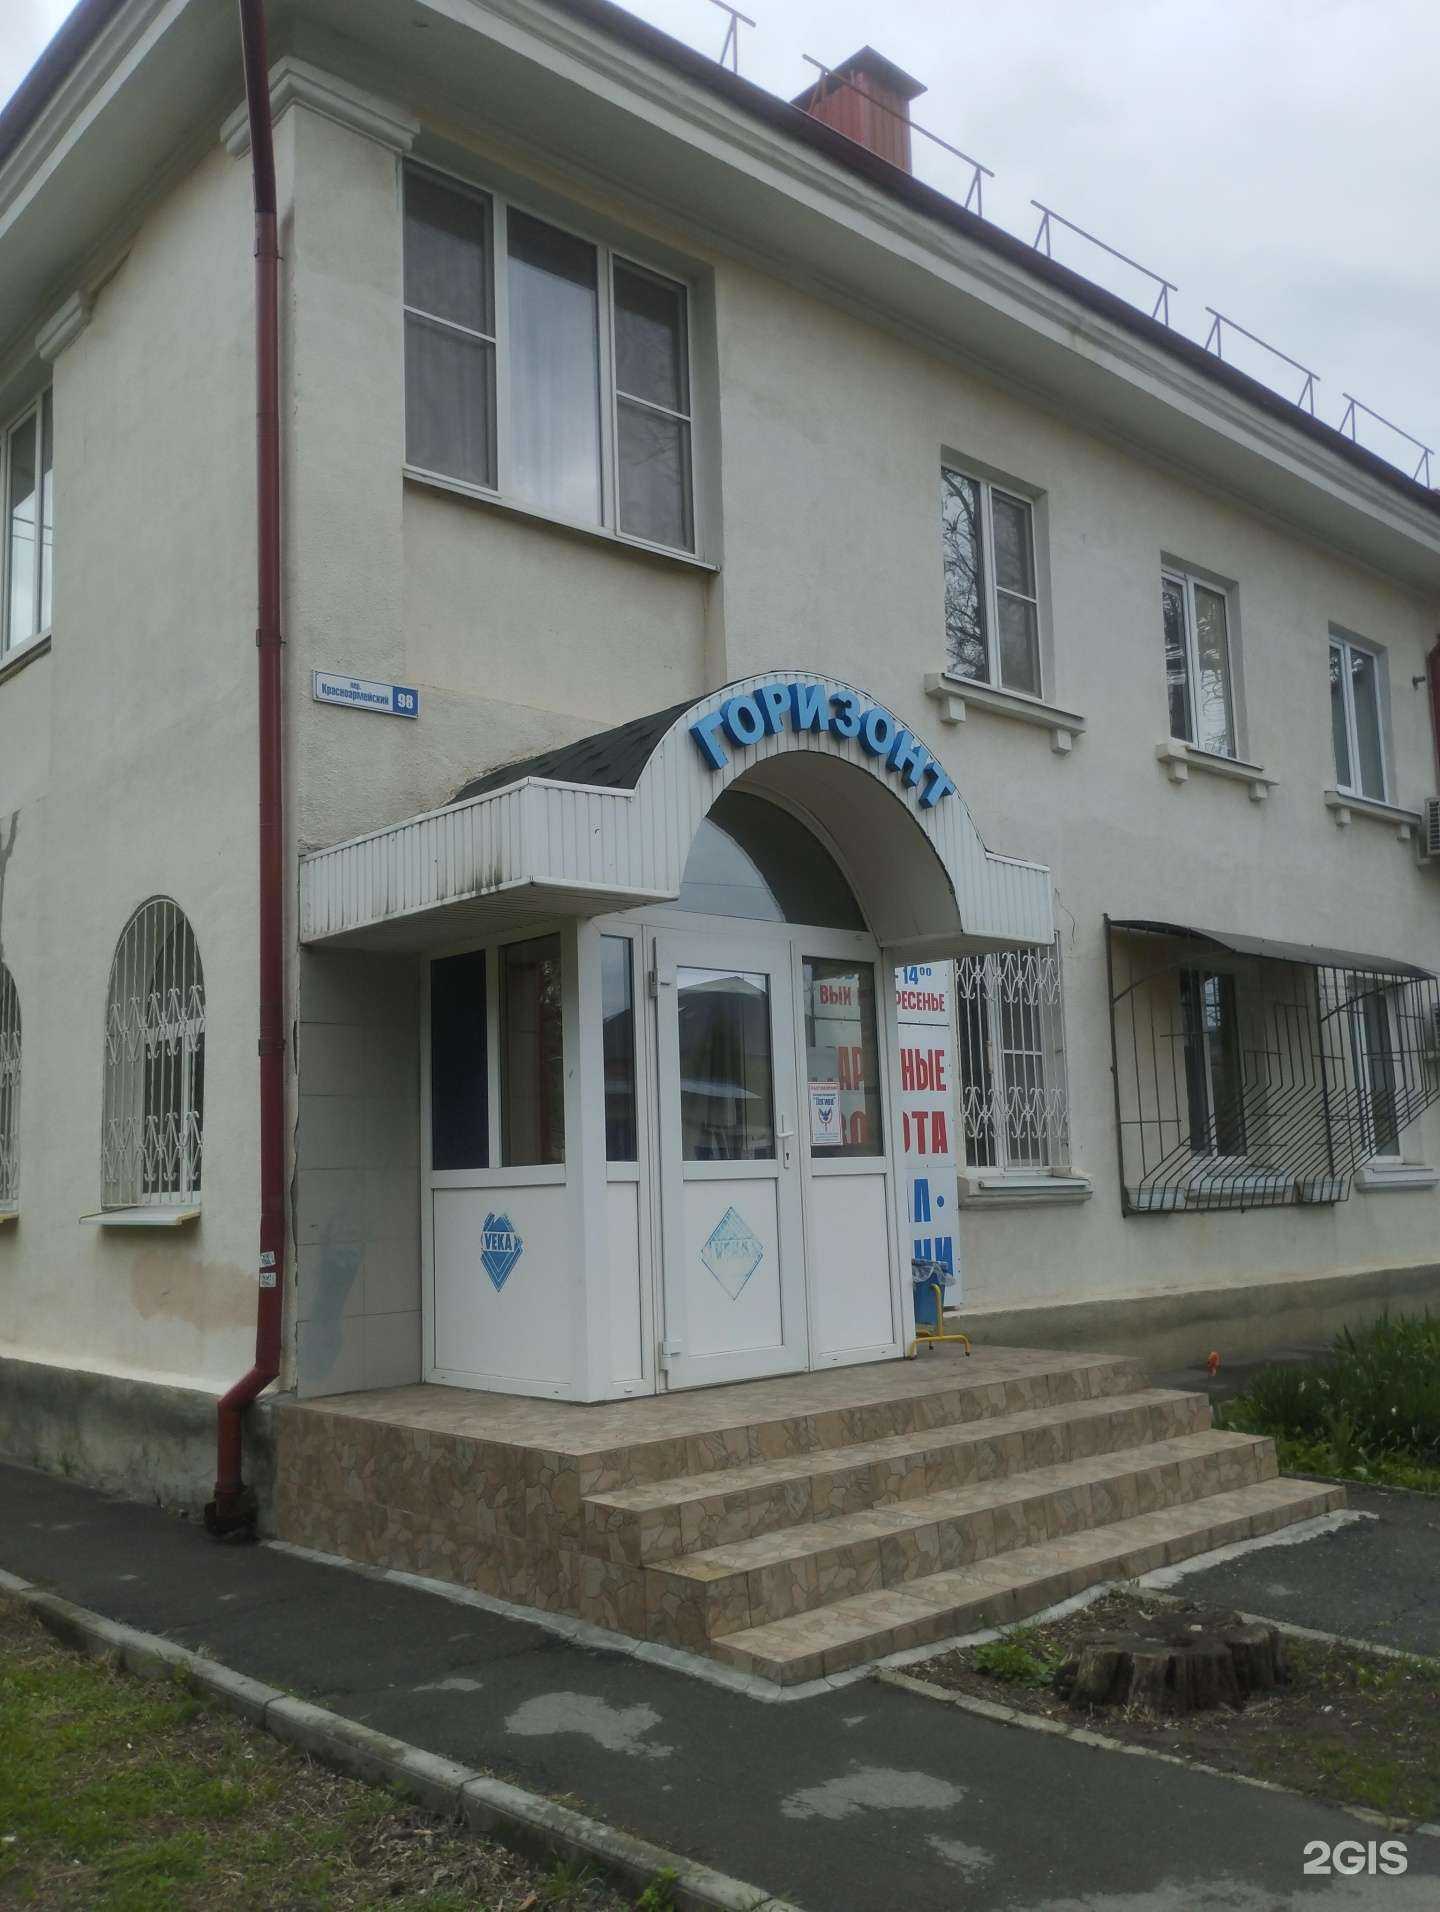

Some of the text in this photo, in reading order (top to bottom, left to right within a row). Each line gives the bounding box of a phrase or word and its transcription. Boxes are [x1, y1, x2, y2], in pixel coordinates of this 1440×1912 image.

[321, 683, 414, 709] Красноармейский 98
[689, 683, 956, 809] ГОРИЗОНТ
[484, 1232, 513, 1251] VEKA
